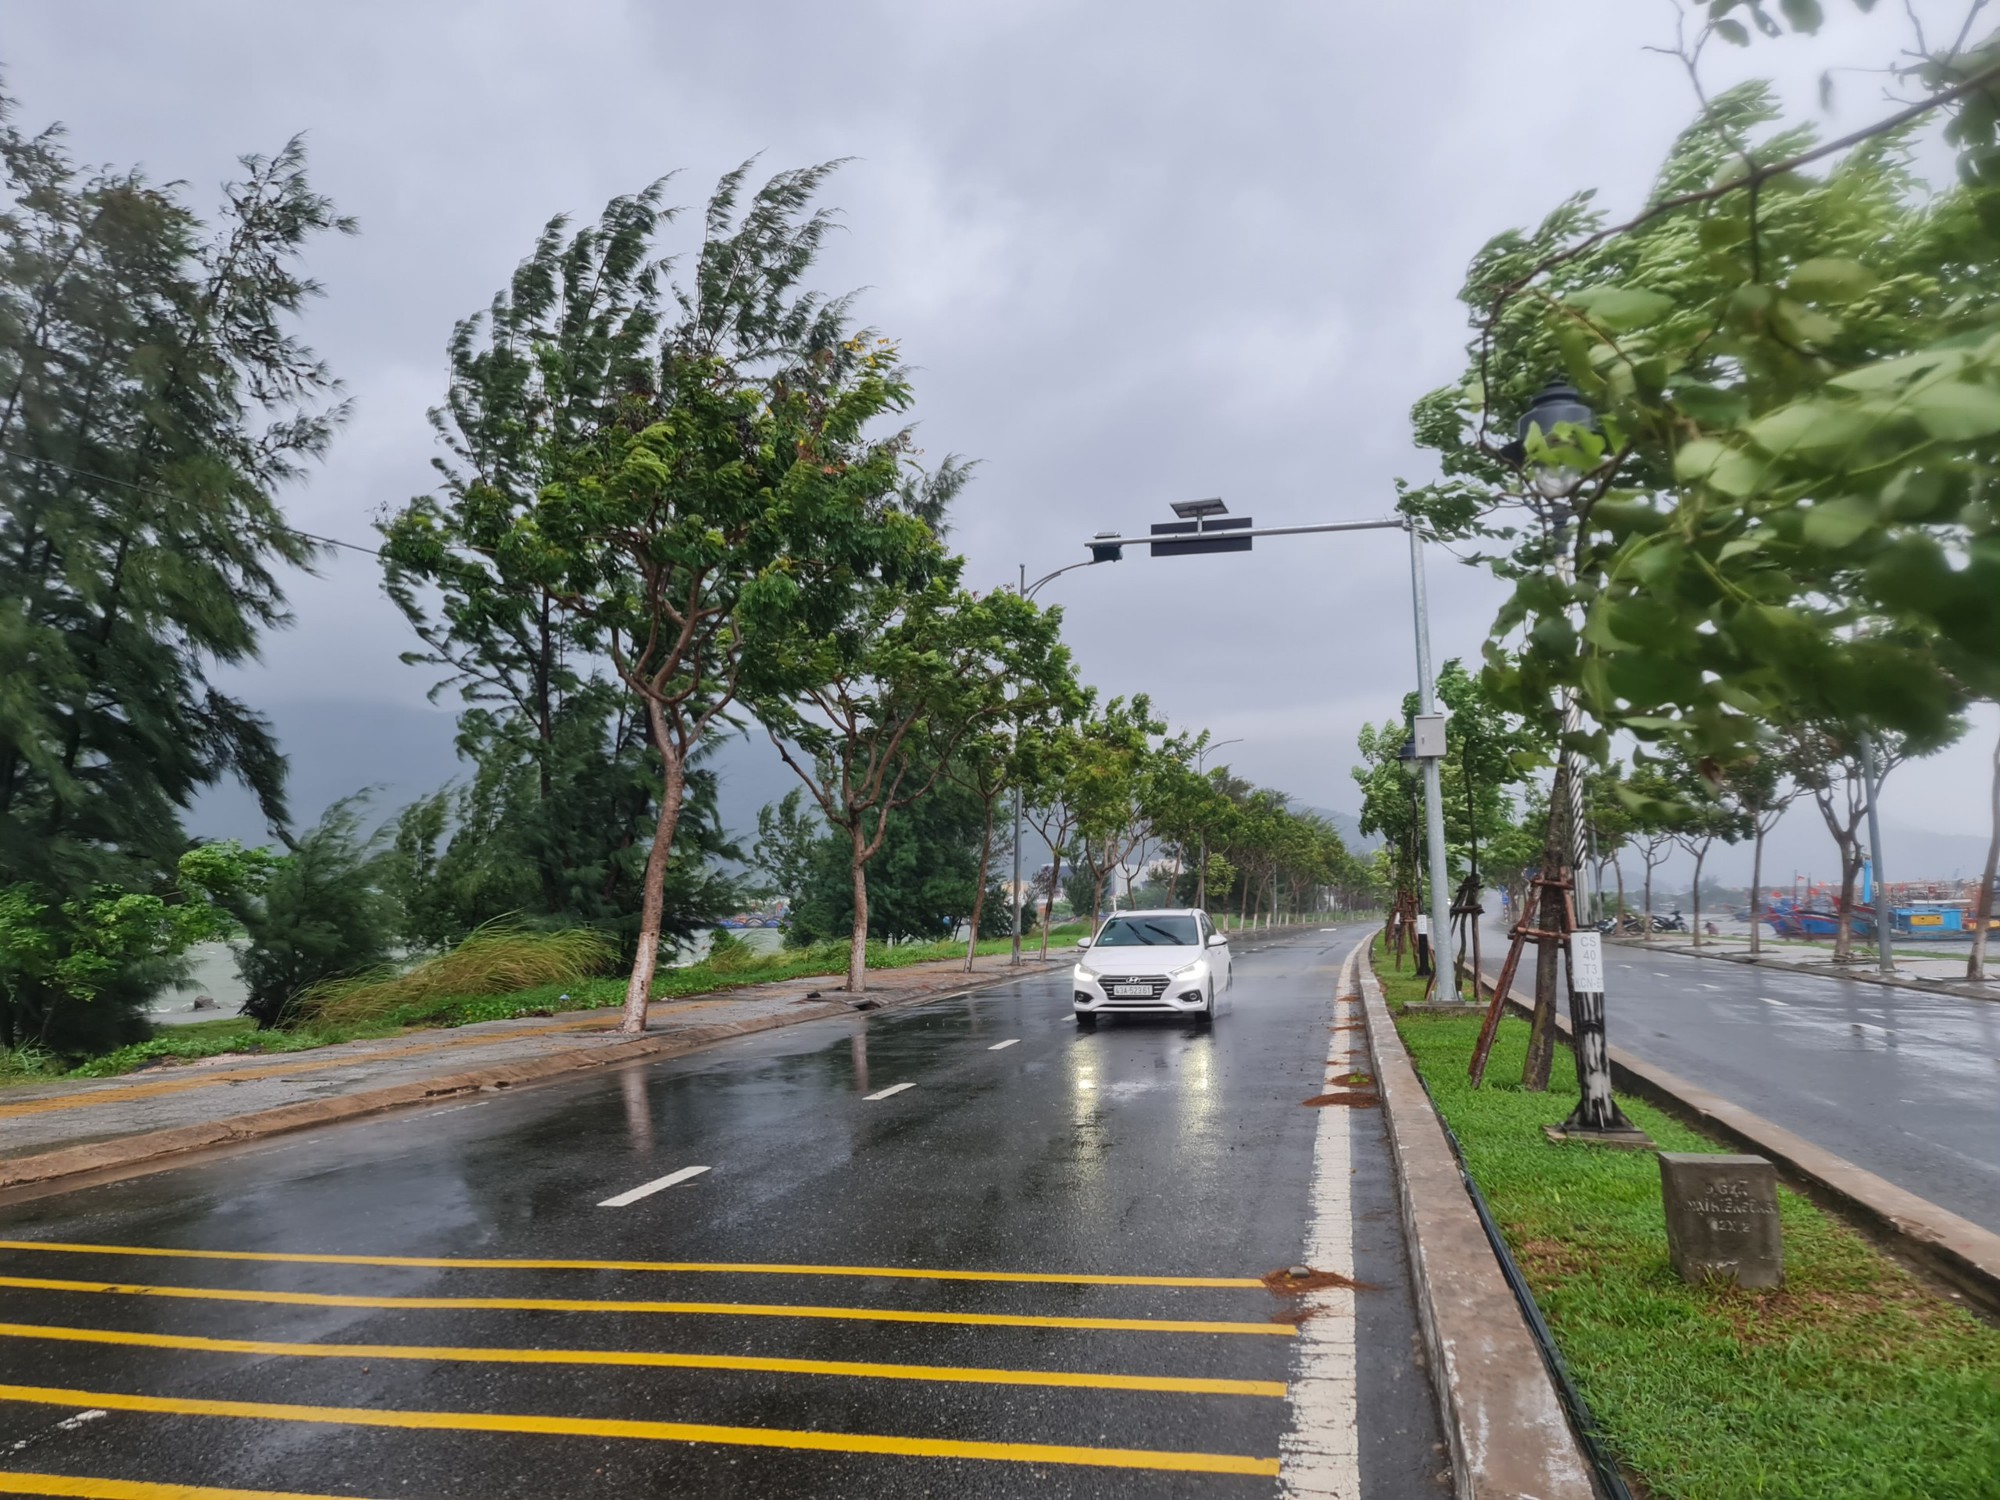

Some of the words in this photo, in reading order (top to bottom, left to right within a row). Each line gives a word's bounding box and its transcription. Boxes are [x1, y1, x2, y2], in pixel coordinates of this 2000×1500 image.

[1580, 936, 1597, 947] CS
[1583, 950, 1597, 961] 40
[1583, 964, 1598, 975] T3
